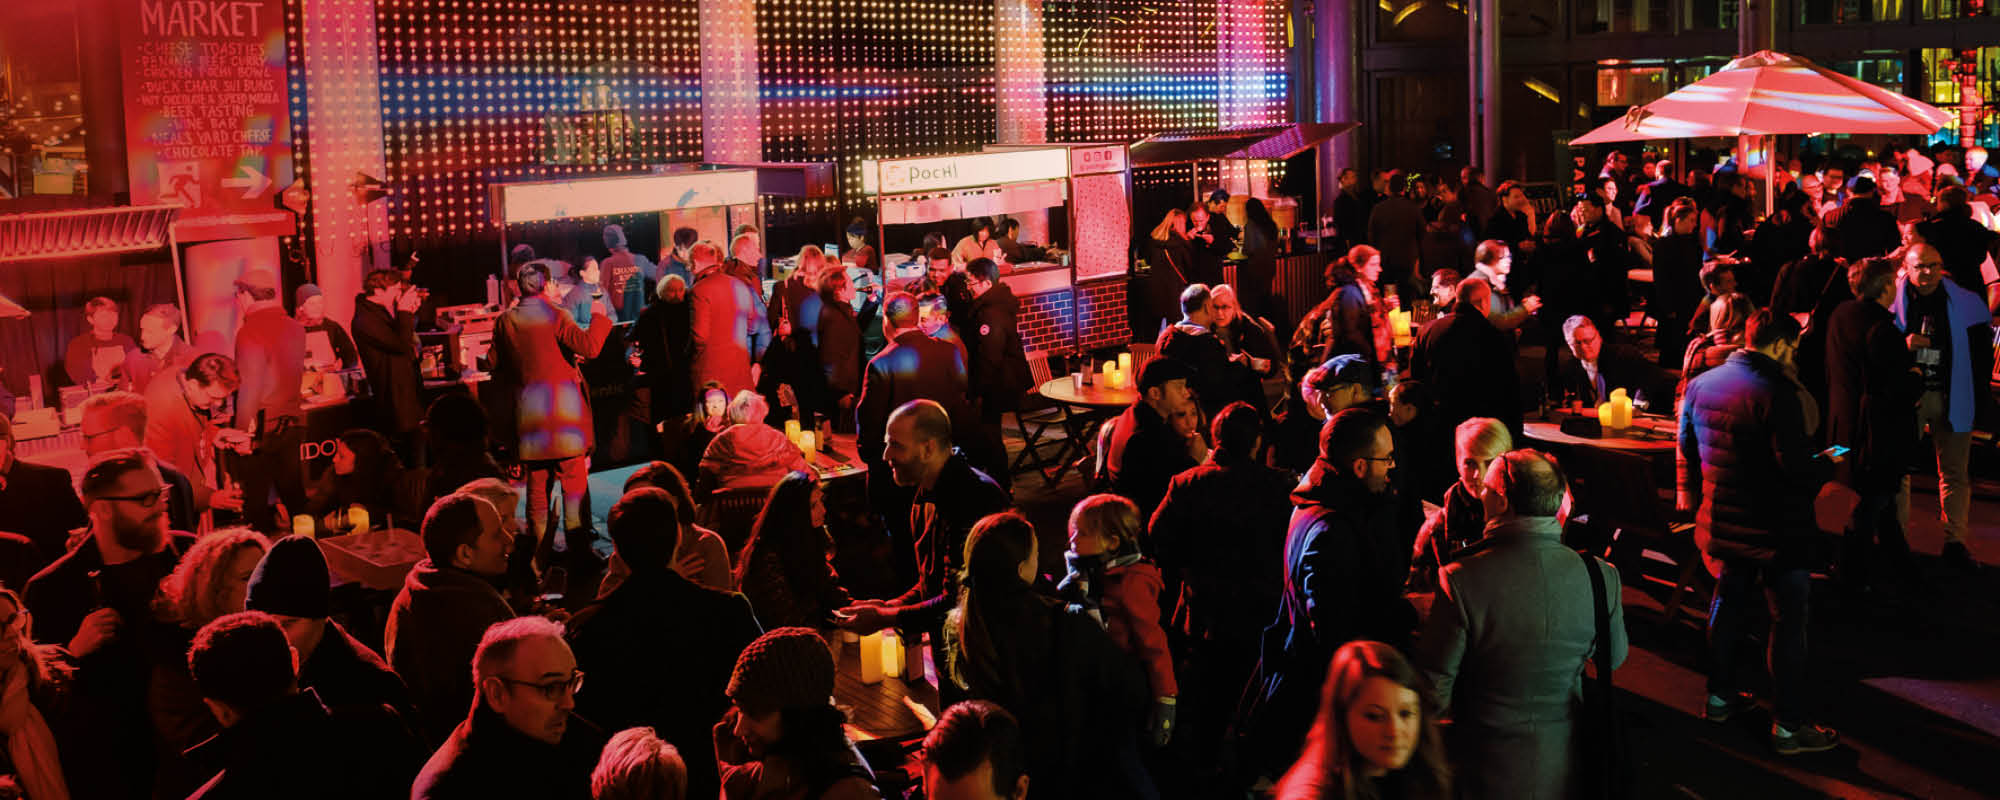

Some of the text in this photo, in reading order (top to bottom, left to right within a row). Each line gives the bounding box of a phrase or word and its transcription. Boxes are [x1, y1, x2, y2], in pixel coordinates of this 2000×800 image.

[141, 1, 263, 36] MARKET
[143, 41, 265, 56] CHEESE TOASTIES
[146, 81, 179, 93] DUCK
[184, 80, 217, 93] CHAR
[244, 80, 274, 92] BUNS
[163, 105, 254, 118] BEER TASTING
[210, 118, 237, 129] BAR
